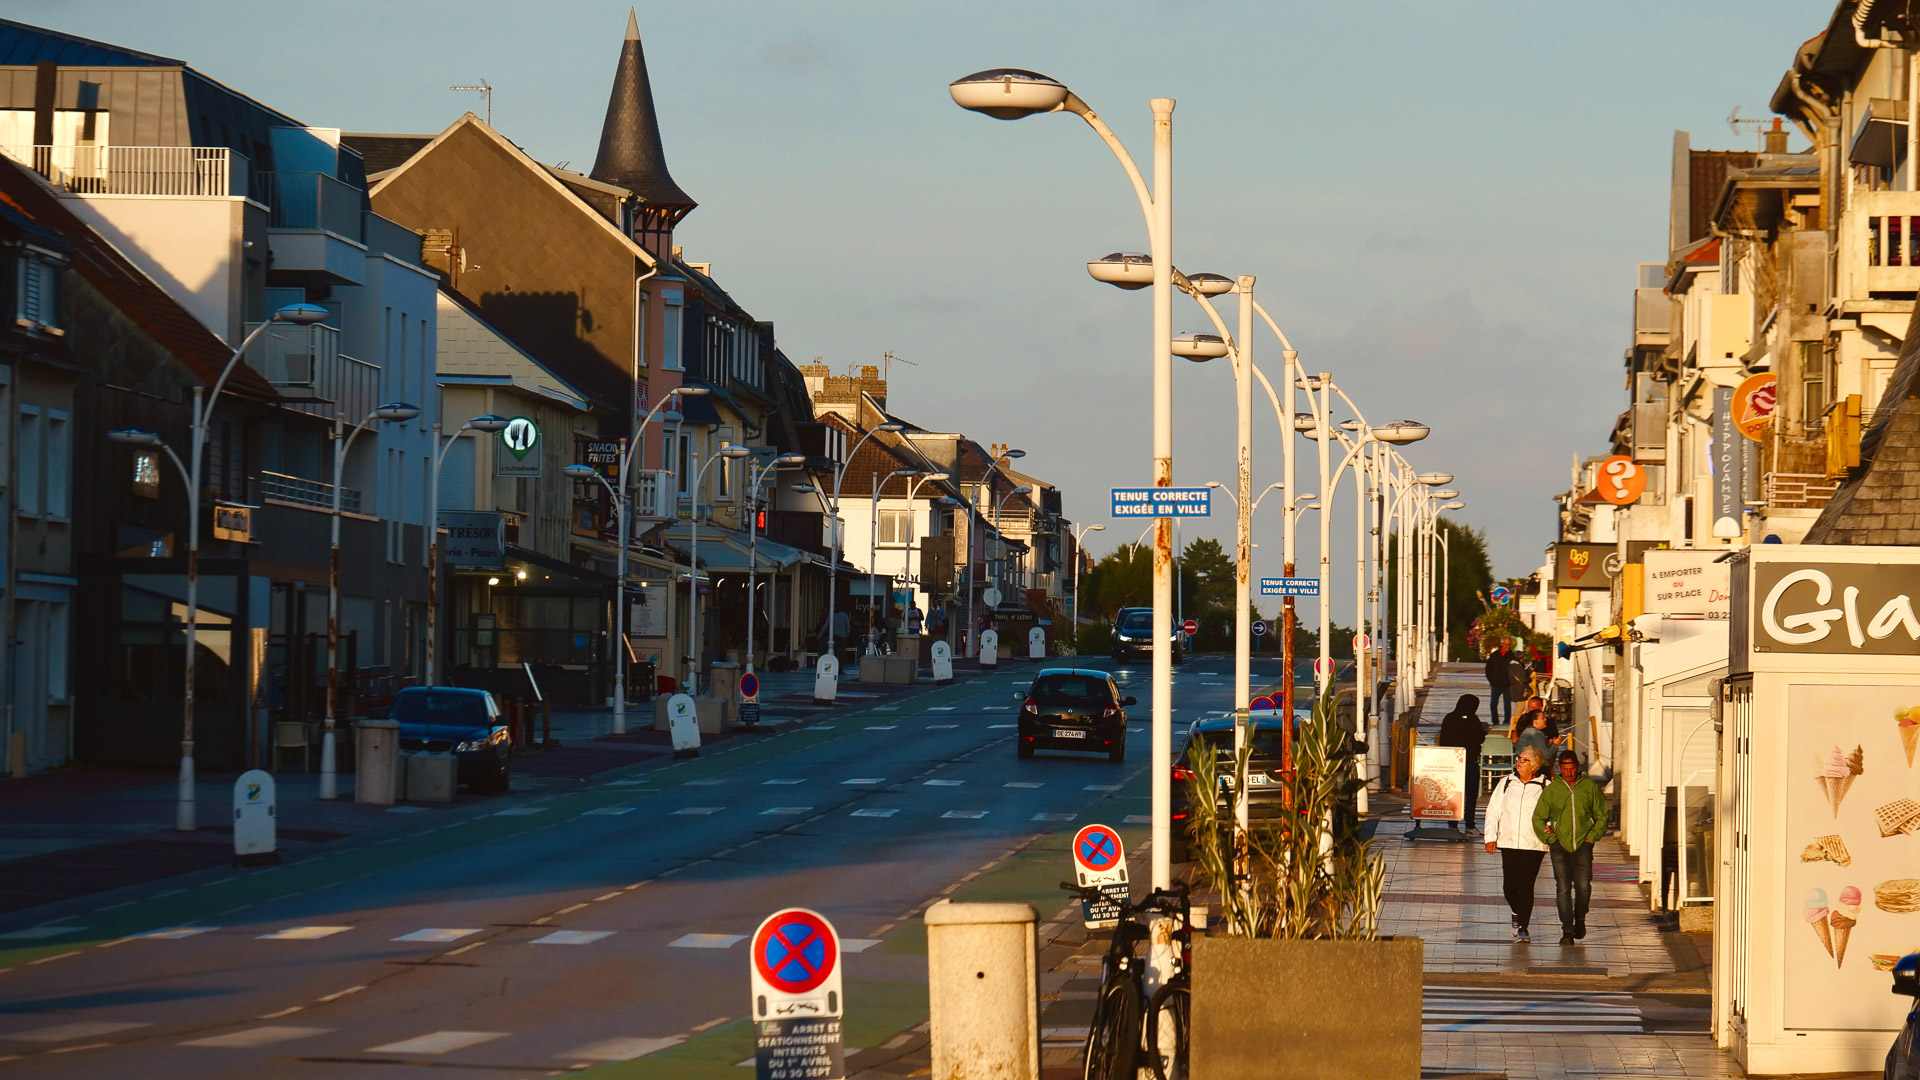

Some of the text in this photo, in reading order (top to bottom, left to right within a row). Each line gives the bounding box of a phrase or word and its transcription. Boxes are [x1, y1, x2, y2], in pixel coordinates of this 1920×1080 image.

[587, 453, 616, 463] FRITES
[1113, 491, 1208, 502] TENUE CORRECTE
[1114, 503, 1208, 515] EXIGÉE EN VILLE
[1659, 567, 1703, 579] EMPORTER
[1657, 589, 1702, 601] SUR PLACE
[1708, 611, 1720, 619] 03
[792, 1023, 825, 1035] ARRET
[827, 1022, 841, 1033] ET
[757, 1033, 842, 1048] STATIONNEMENT
[773, 1045, 827, 1058] INTERDITS
[768, 1058, 785, 1069] DU
[800, 1055, 833, 1067] AVRIL
[771, 1066, 832, 1080] AU 30 SEPT
